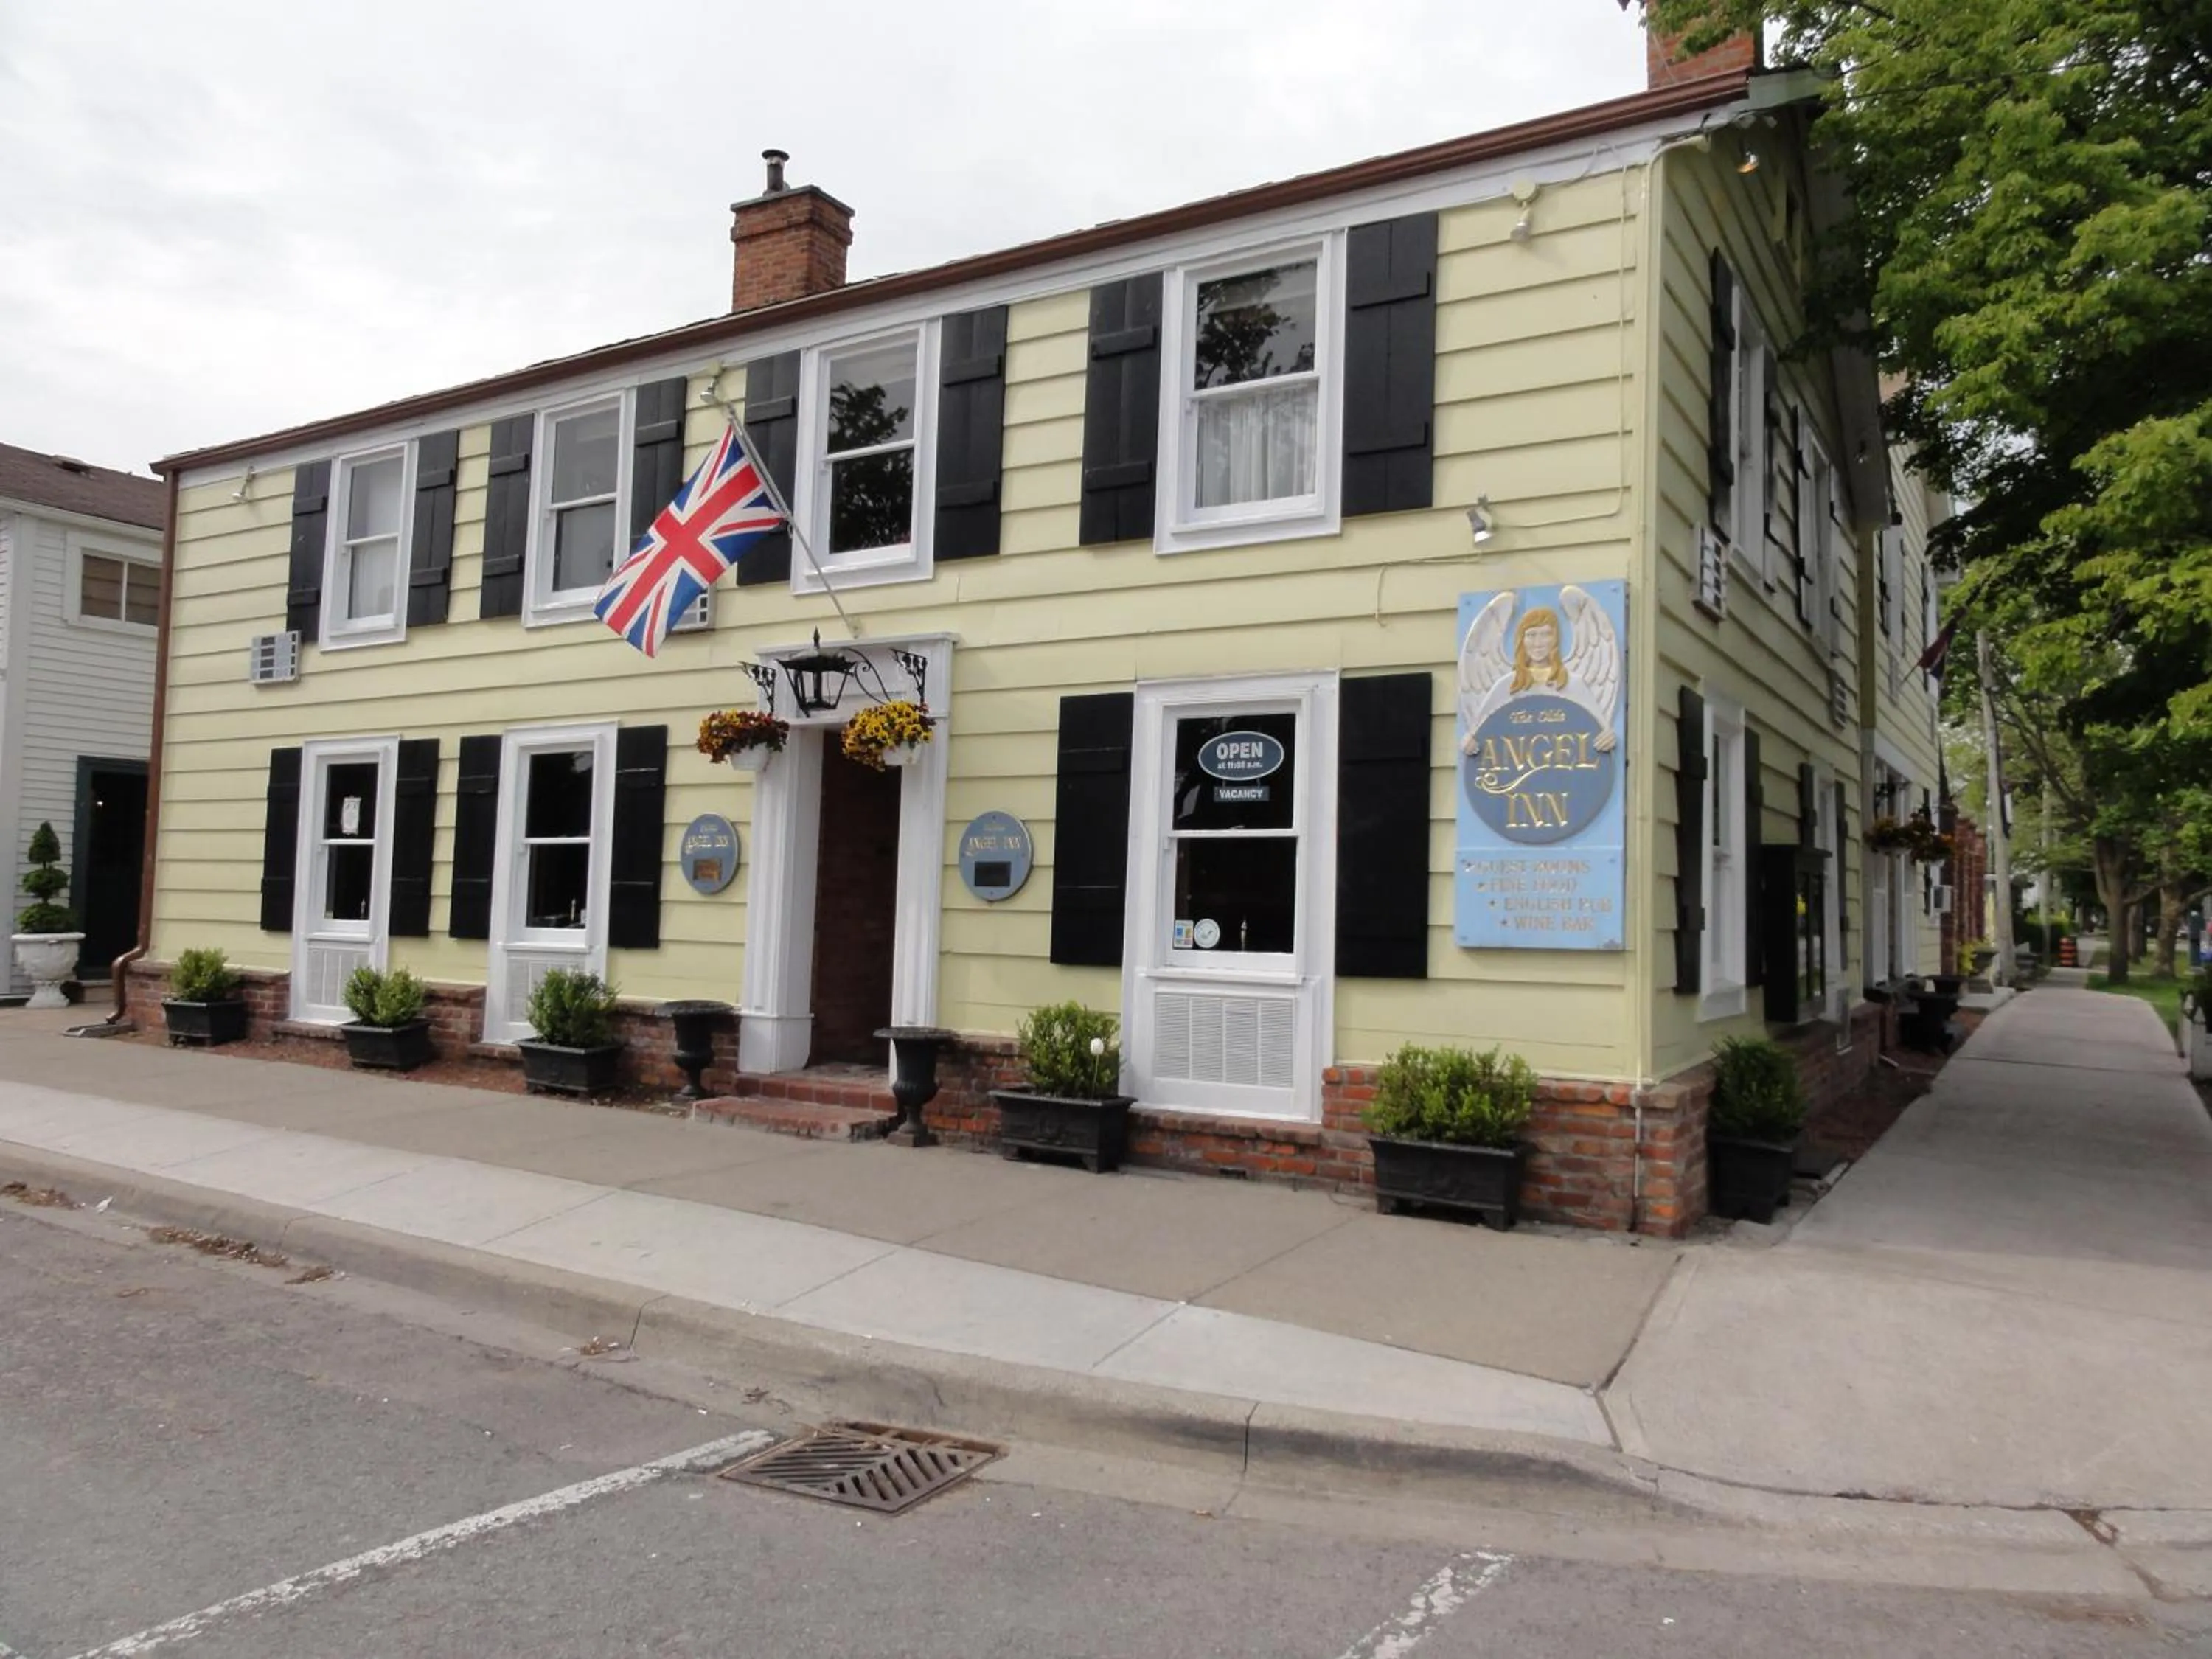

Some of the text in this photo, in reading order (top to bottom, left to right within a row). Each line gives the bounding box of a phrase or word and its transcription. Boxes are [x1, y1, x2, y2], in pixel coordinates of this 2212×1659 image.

[1217, 742, 1263, 759] OPEN
[1477, 732, 1599, 771] ANGEL
[1219, 789, 1263, 799] VACANCY
[1506, 792, 1568, 827] INN
[1504, 897, 1612, 912] ENGLISH PUB
[1514, 916, 1593, 931] WINE BAR
